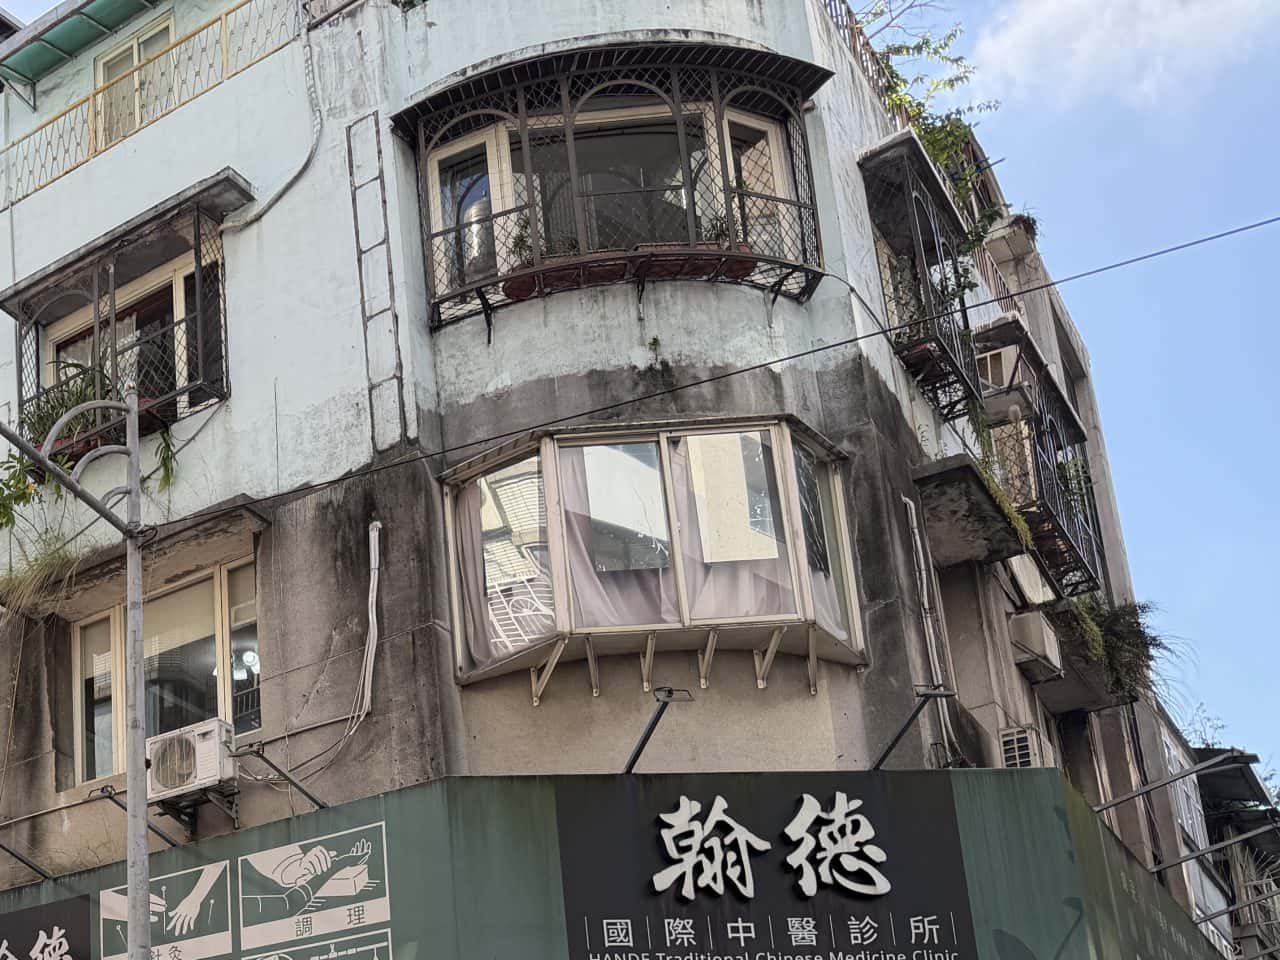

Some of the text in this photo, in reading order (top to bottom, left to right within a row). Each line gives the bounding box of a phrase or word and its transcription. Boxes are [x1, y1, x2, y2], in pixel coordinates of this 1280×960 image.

[652, 791, 892, 900] 翰德
[293, 904, 367, 938] 調理
[602, 915, 941, 948] 國際中醫診所
